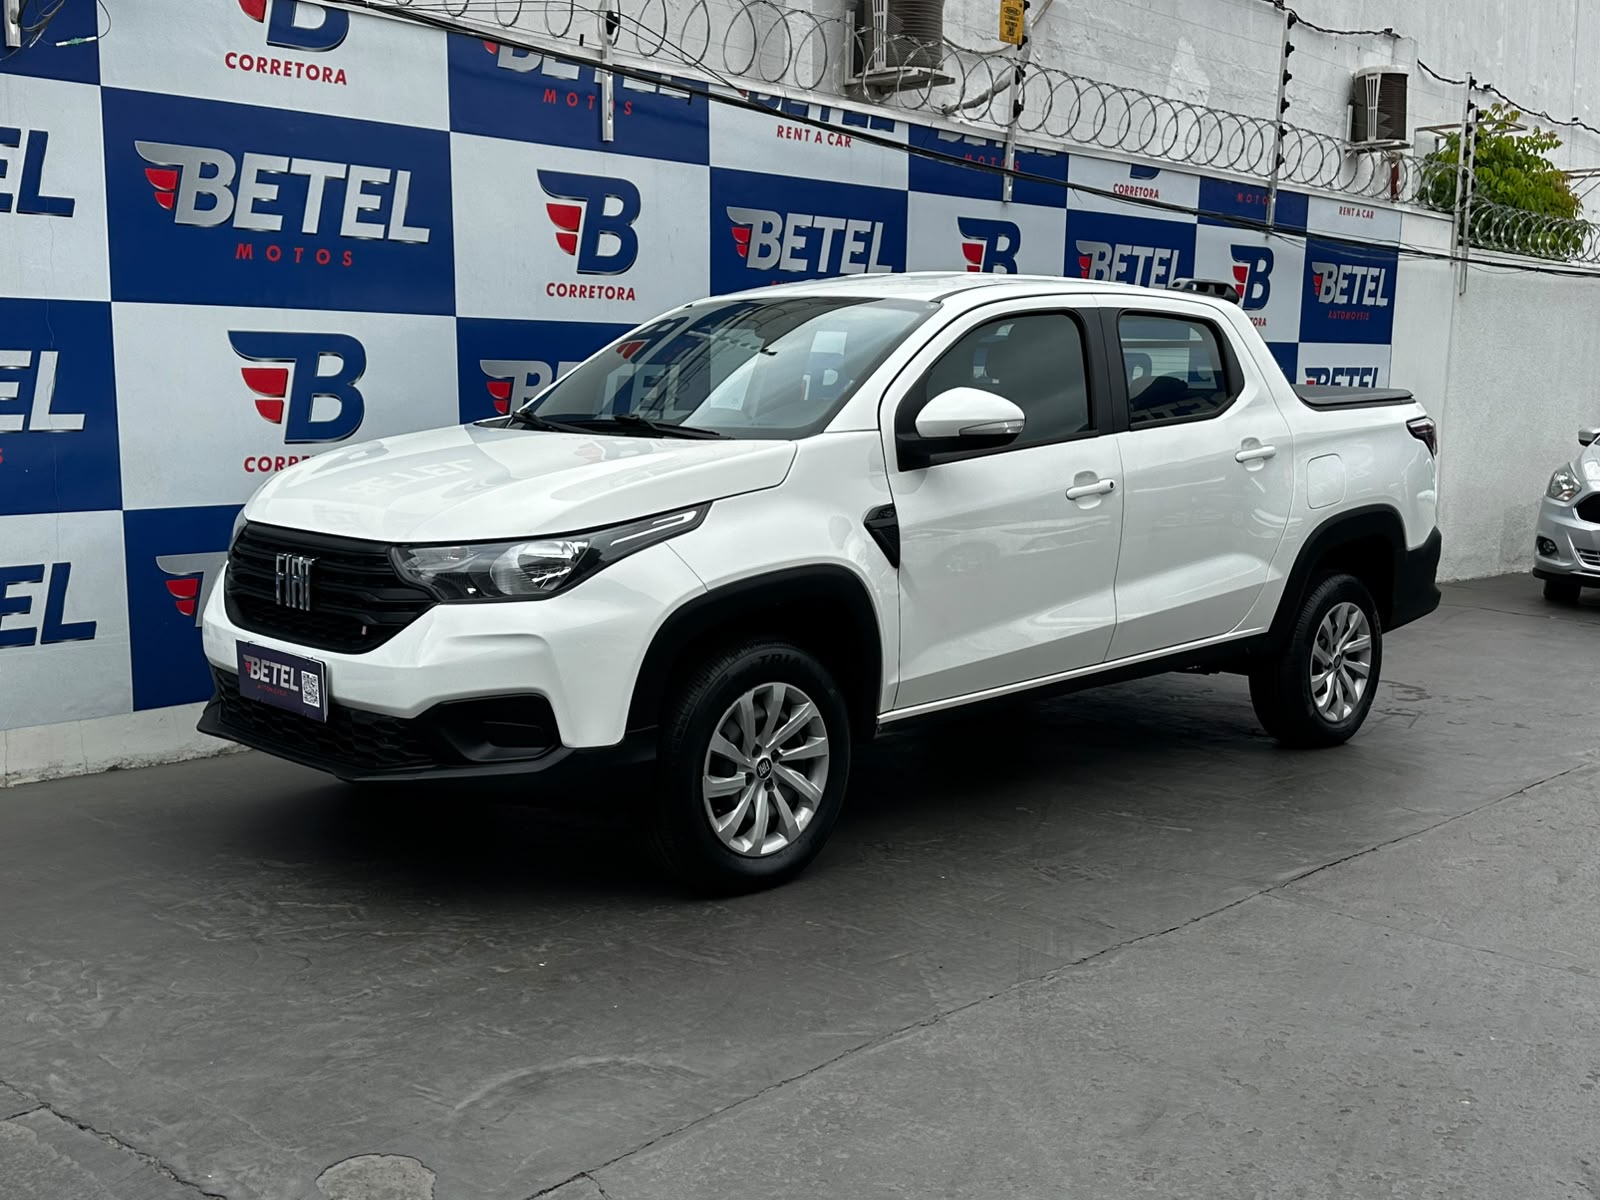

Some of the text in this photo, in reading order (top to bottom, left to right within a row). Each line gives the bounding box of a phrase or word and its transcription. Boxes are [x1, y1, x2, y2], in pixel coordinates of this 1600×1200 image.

[225, 52, 348, 86] CORRETORA
[543, 88, 633, 115] MOTS
[776, 125, 852, 148] RENT A CAR
[134, 140, 431, 244] BETEL
[1113, 183, 1160, 199] CORRETORA
[537, 168, 642, 276] B
[1338, 206, 1355, 217] RENT
[1362, 209, 1375, 219] CAR
[235, 243, 354, 268] MOTOS
[726, 206, 893, 274] BETEL
[546, 282, 636, 301] CORRETORA
[1311, 261, 1389, 308] BETEL
[227, 330, 368, 445] B
[275, 552, 319, 612] FIAT
[242, 654, 300, 692] BETEL
